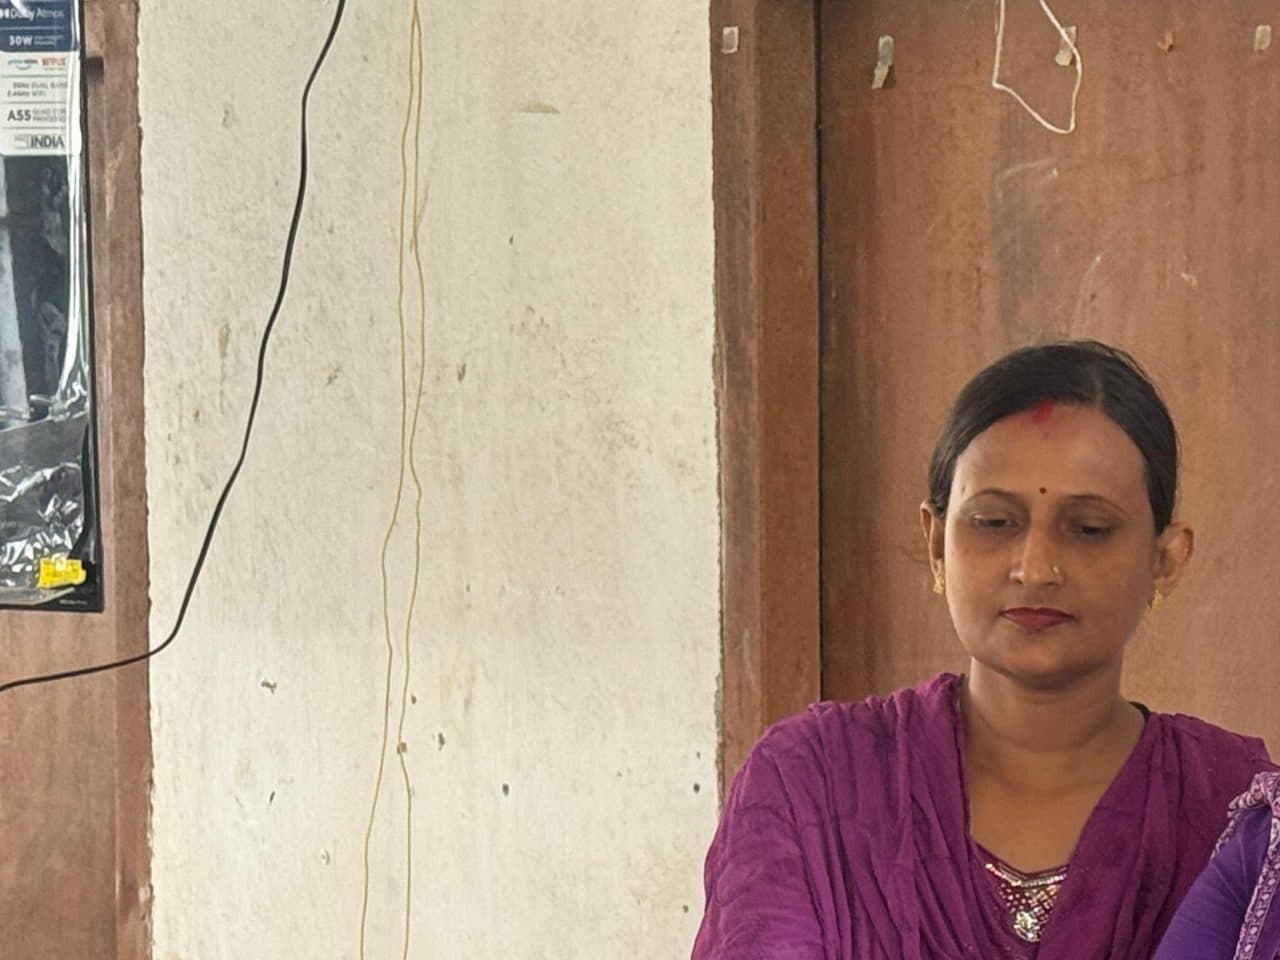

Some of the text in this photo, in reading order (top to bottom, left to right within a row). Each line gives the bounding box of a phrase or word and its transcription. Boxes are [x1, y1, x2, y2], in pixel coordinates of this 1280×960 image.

[9, 35, 33, 46] 30W
[8, 109, 31, 122] A55
[31, 135, 65, 149] INDIA
